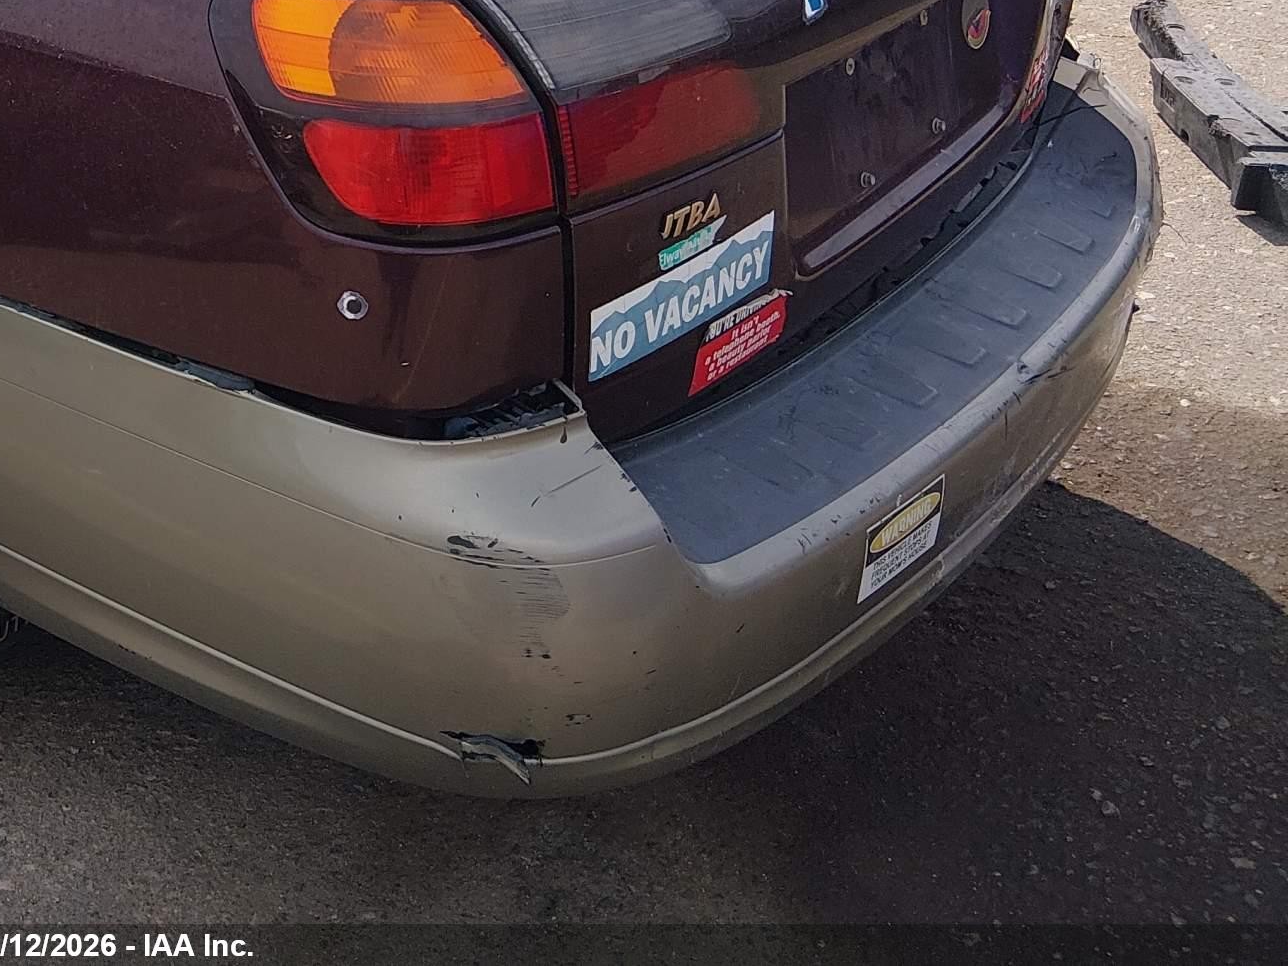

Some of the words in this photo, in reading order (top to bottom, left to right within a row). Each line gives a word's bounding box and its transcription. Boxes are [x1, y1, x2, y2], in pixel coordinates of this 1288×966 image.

[590, 320, 636, 373] NO
[644, 240, 770, 344] VACANCY
[881, 498, 932, 546] WARNING
